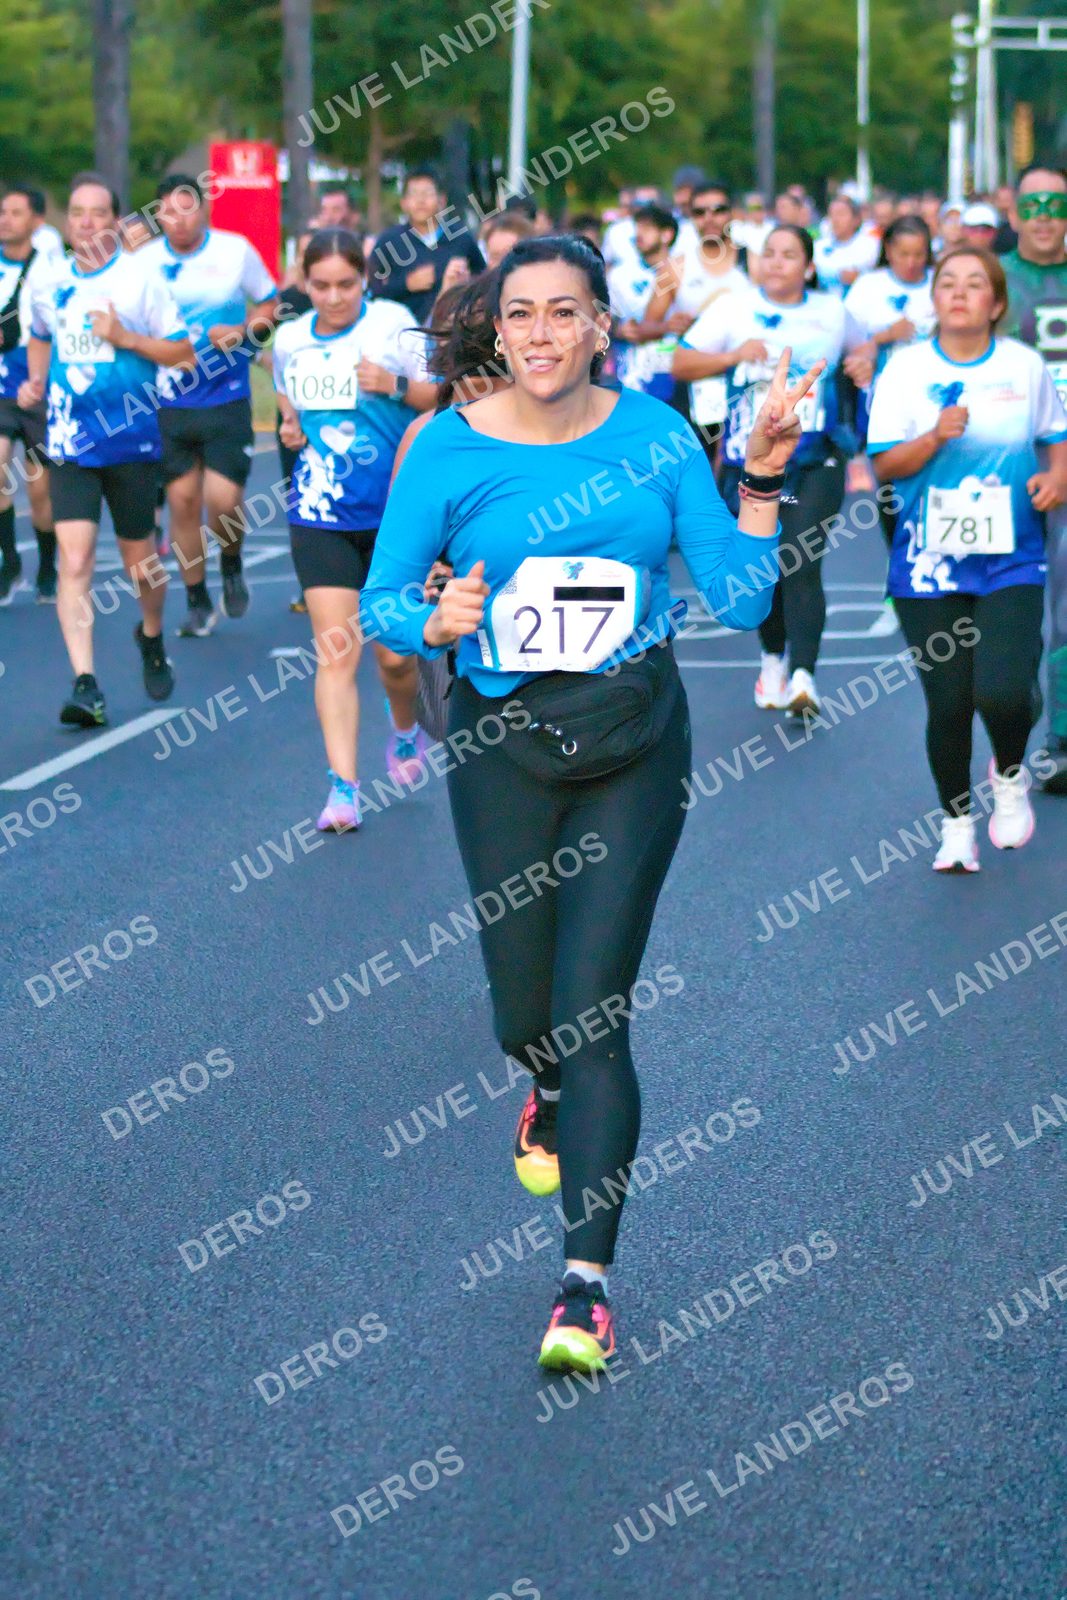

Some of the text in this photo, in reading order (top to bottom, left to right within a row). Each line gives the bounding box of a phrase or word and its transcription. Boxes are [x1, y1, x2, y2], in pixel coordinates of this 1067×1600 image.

[65, 333, 104, 356] 389
[289, 375, 353, 401] 1084
[939, 516, 993, 545] 781
[513, 605, 615, 654] 217
